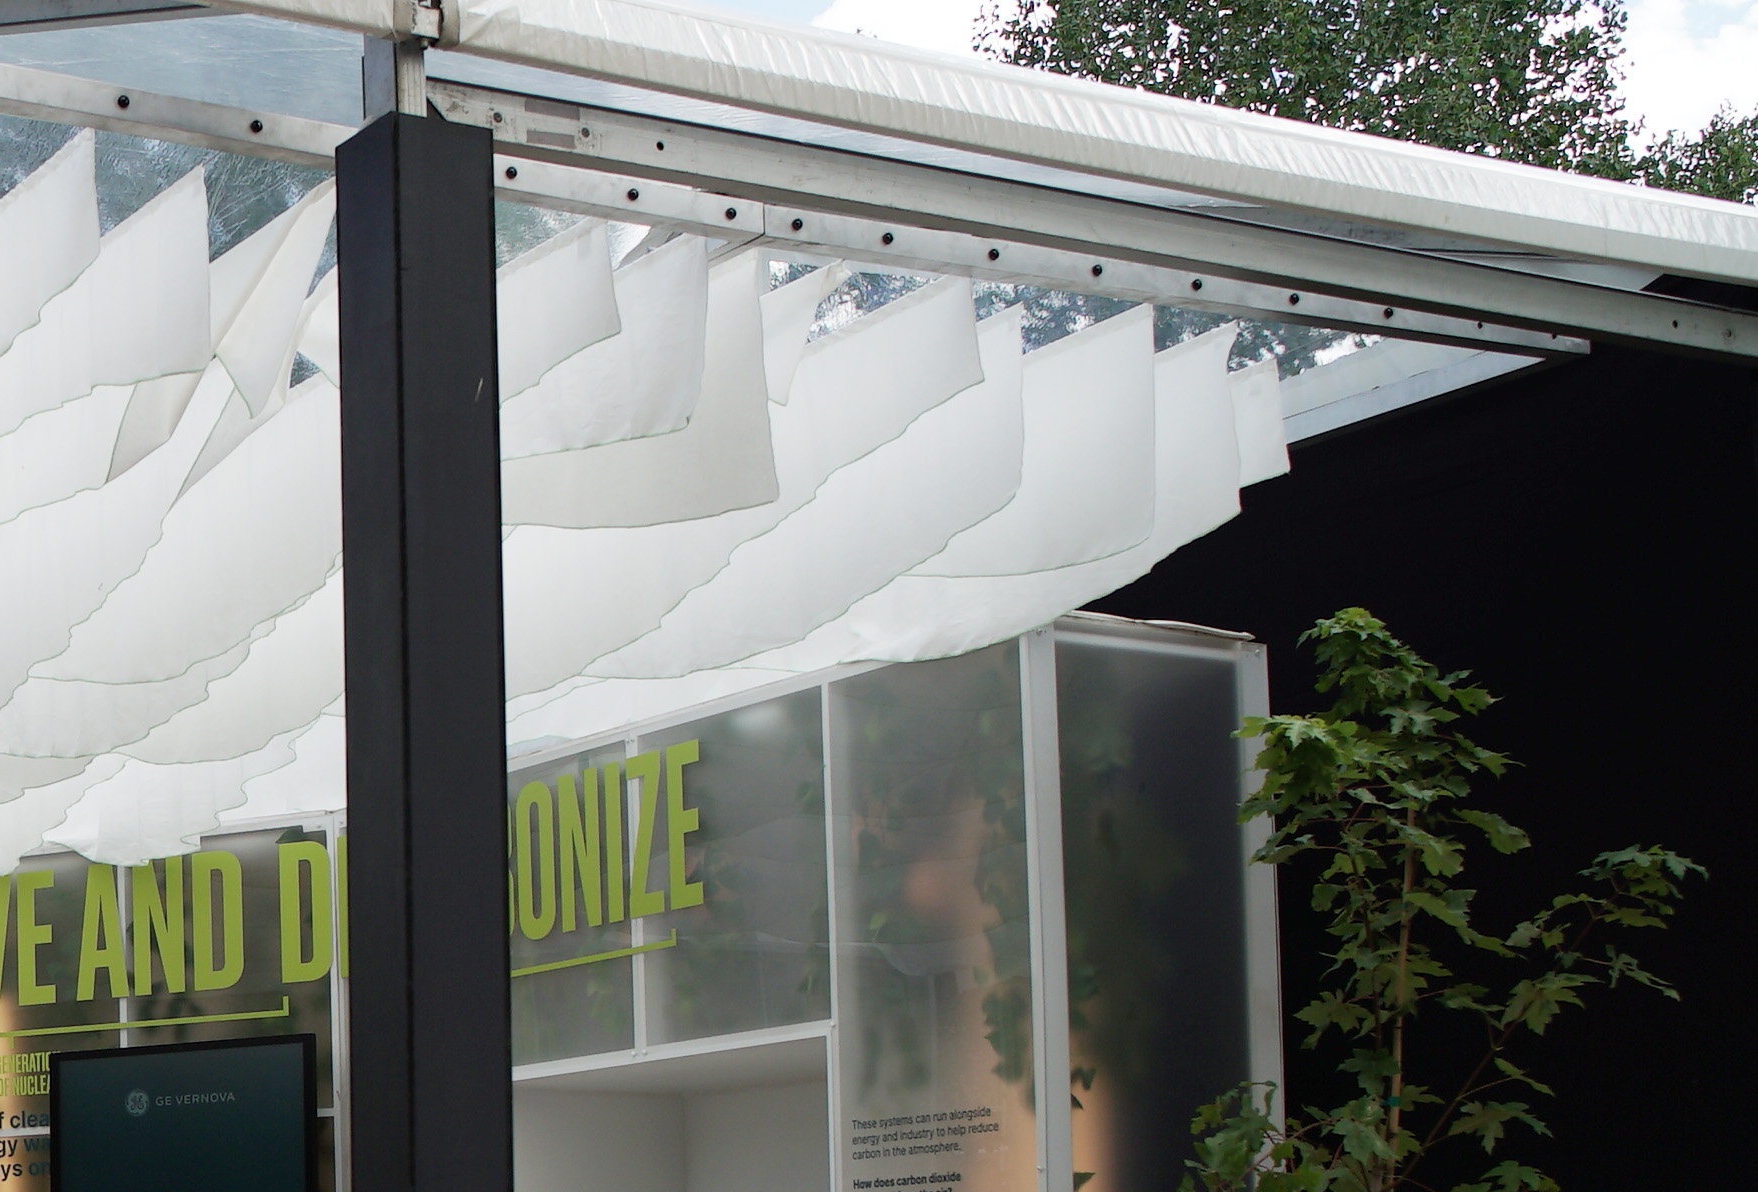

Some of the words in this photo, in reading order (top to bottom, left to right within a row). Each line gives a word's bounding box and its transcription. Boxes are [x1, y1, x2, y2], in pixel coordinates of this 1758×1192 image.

[76, 851, 245, 1002] AND
[12, 1074, 51, 1096] NUCLEA
[156, 1096, 173, 1107] GE
[175, 1092, 236, 1105] VERNOVA
[9, 1110, 51, 1128] clea
[852, 1118, 877, 1130] These
[879, 1115, 914, 1129] systems
[915, 1113, 931, 1124] can
[932, 1112, 948, 1122] run
[949, 1105, 992, 1121] alongside
[852, 1134, 881, 1147] energy
[882, 1130, 898, 1142] and
[900, 1128, 935, 1141] industry
[936, 1127, 946, 1137] to
[947, 1124, 967, 1137] help
[967, 1122, 999, 1134] reduce
[852, 1148, 881, 1161] carbon
[883, 1146, 891, 1157] in
[892, 1145, 907, 1157] the
[908, 1141, 962, 1156] atmosphere.
[853, 1178, 873, 1190] How
[873, 1177, 895, 1188] does
[896, 1174, 928, 1187] carbon
[928, 1171, 962, 1184] dioxide
